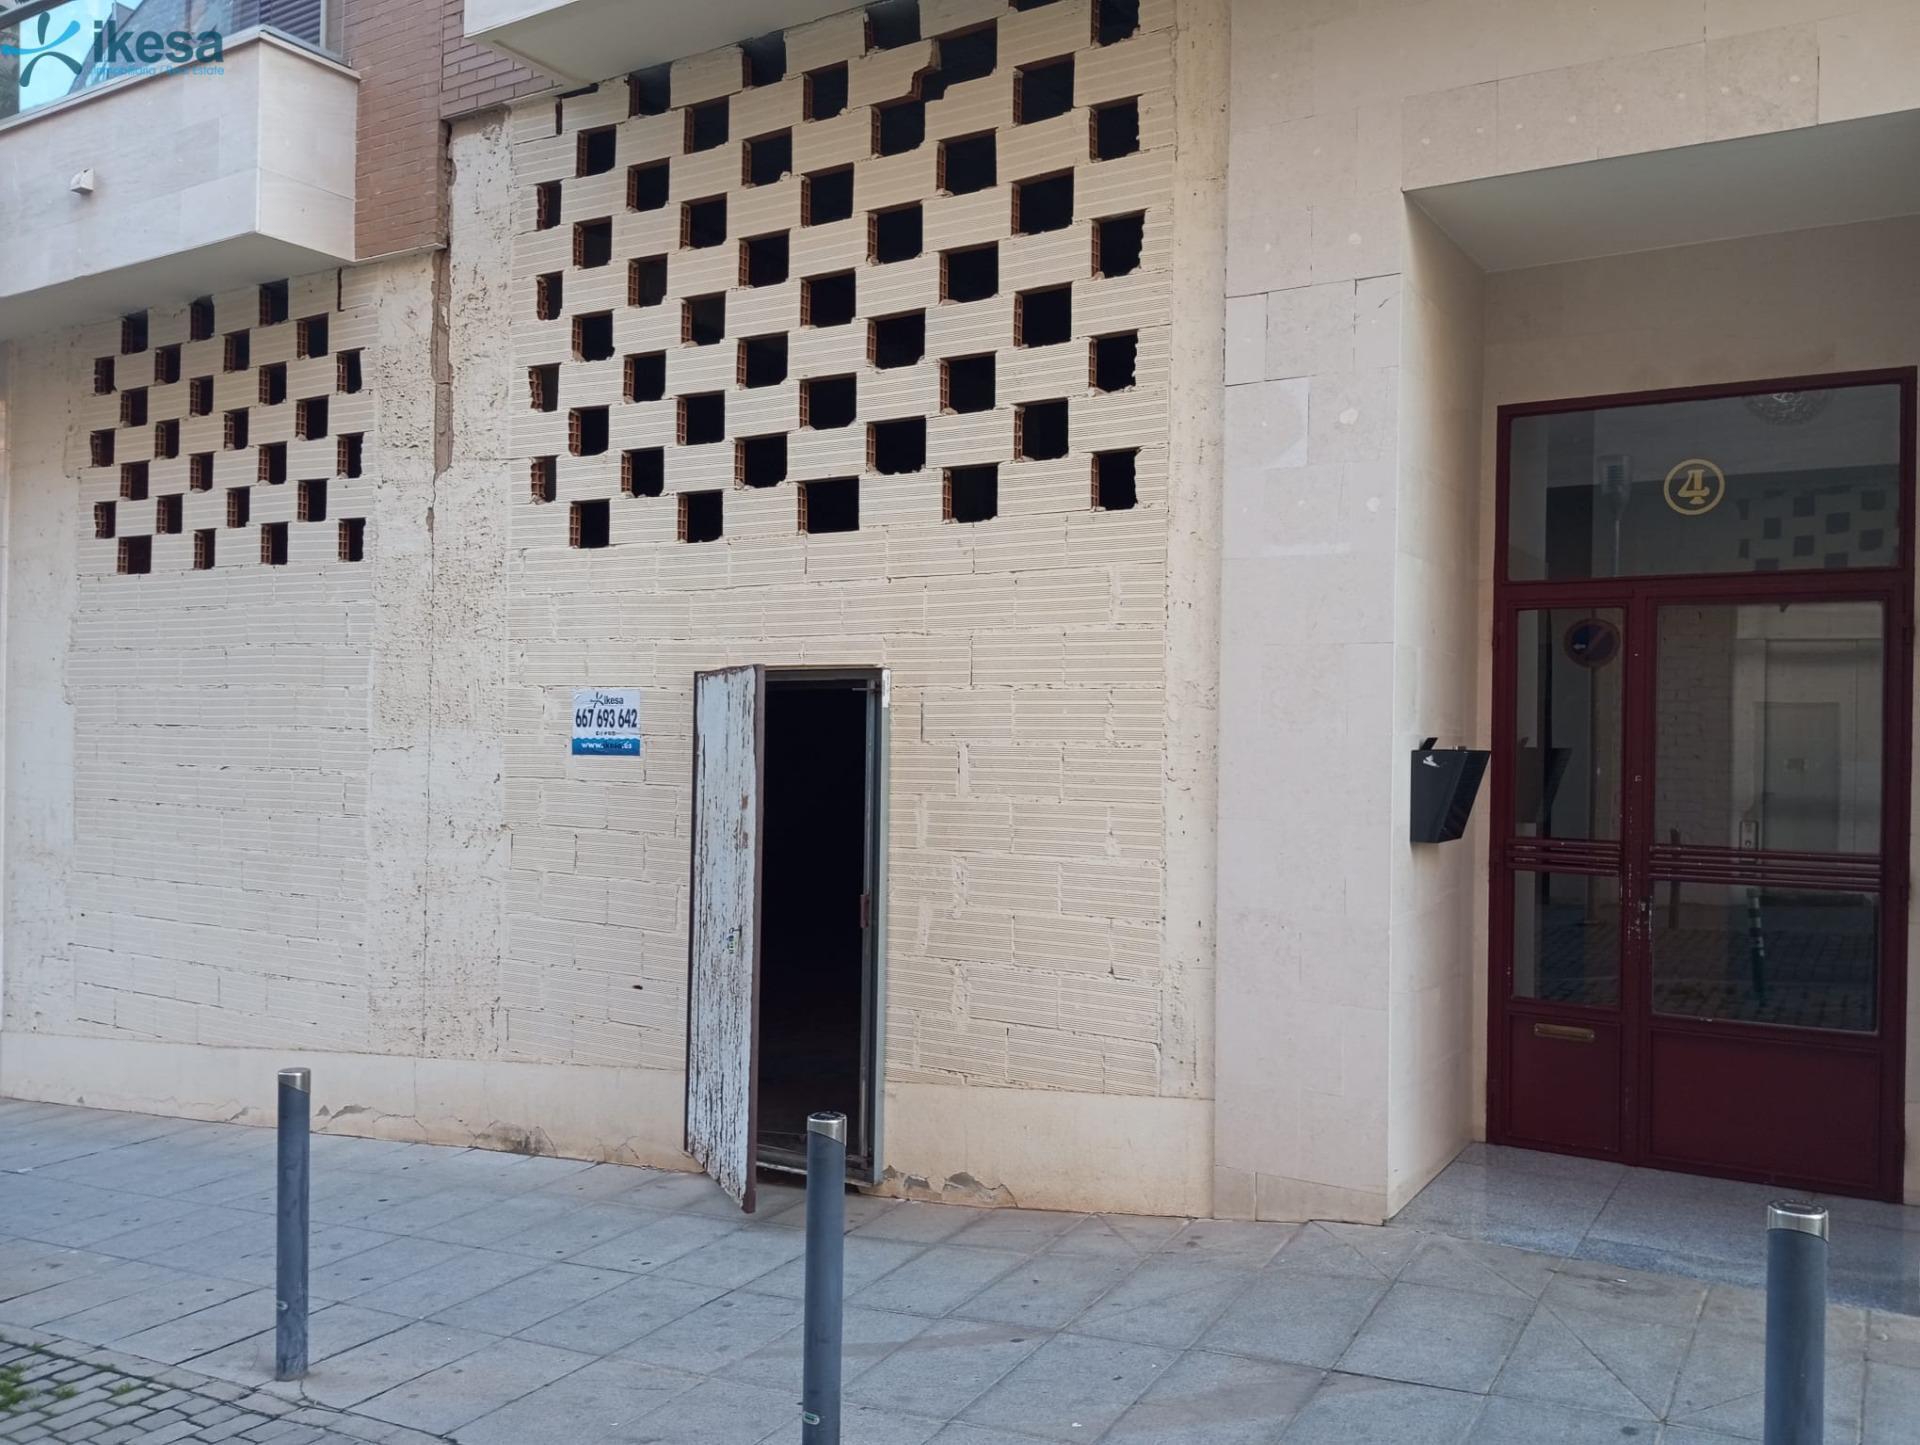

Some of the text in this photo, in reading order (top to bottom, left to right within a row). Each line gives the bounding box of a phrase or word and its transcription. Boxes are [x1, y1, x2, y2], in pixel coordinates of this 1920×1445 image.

[1677, 469, 1710, 505] 4
[576, 708, 638, 728] 667 693 642
